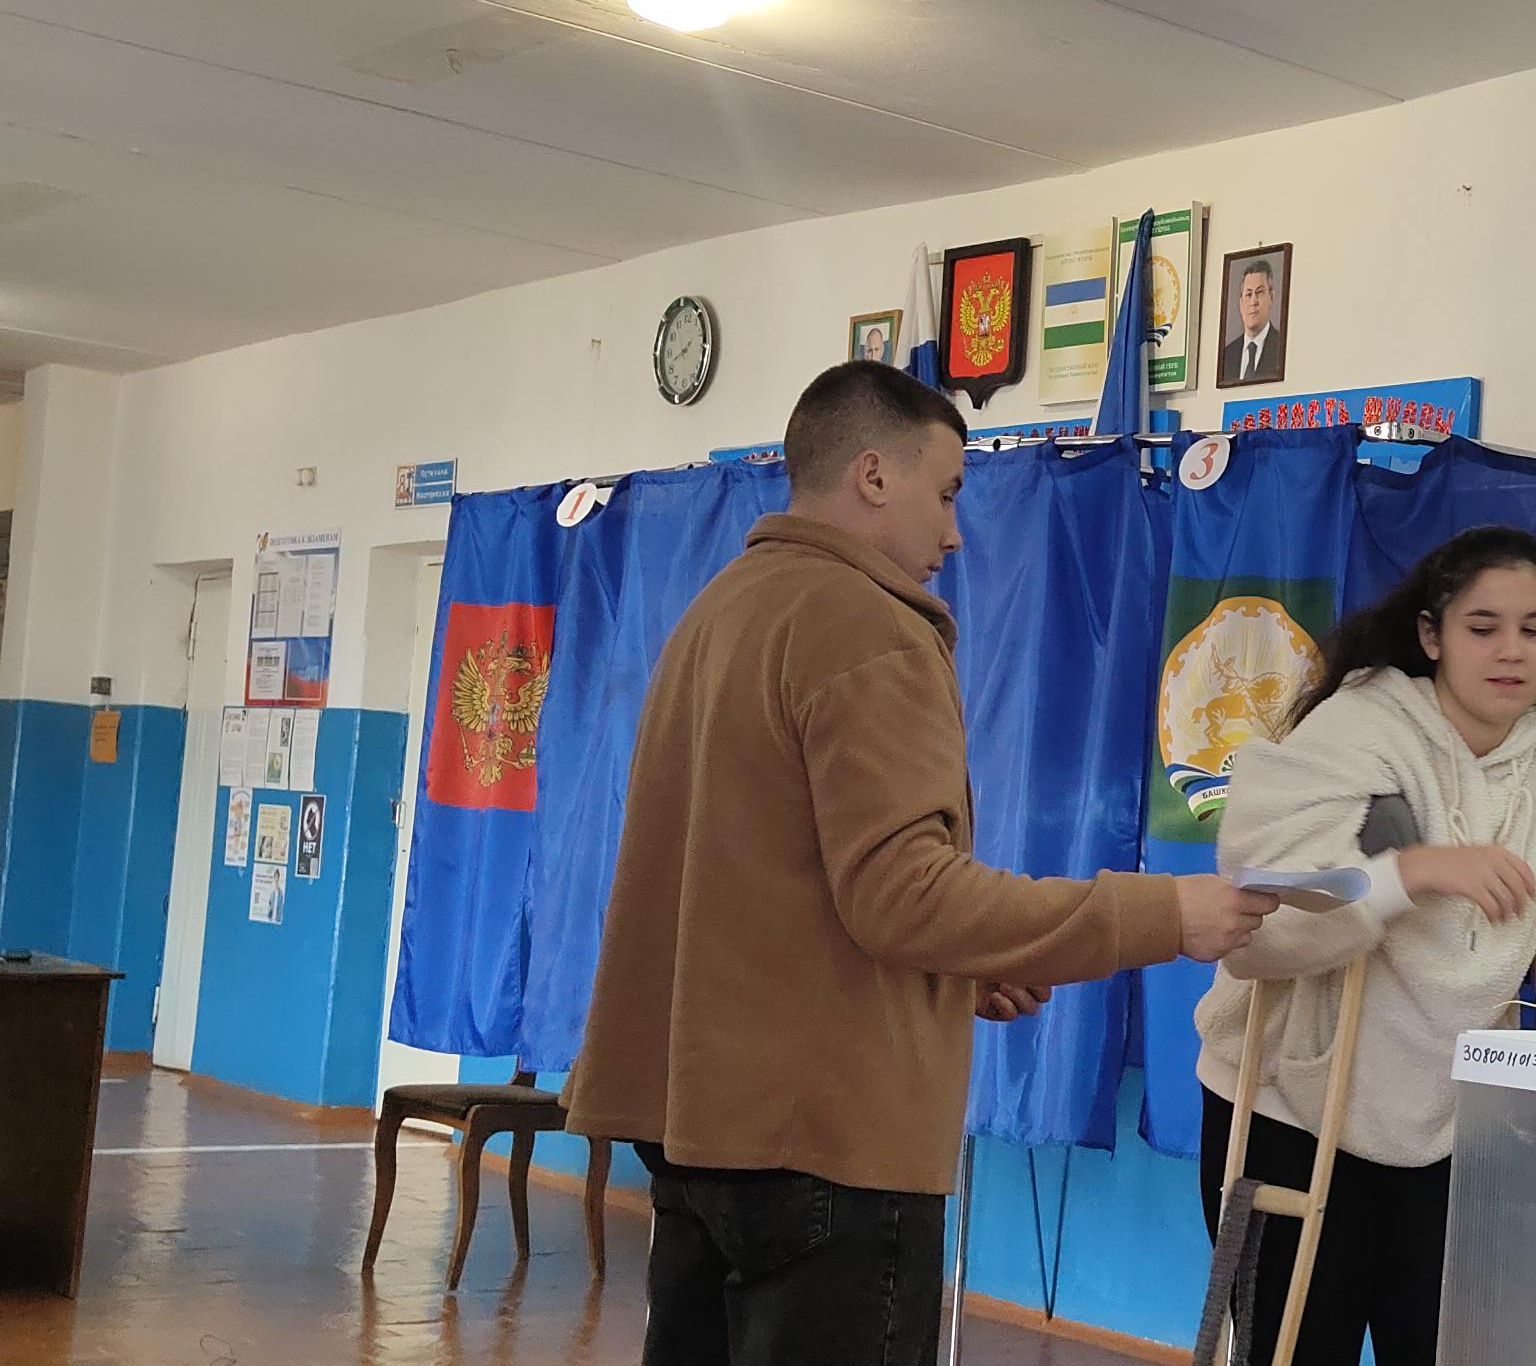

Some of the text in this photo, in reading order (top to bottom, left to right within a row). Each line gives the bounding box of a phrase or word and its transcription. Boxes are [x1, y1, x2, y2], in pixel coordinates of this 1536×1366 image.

[1190, 442, 1219, 481] 3
[563, 490, 587, 520] 1
[302, 841, 317, 854] НЕТ
